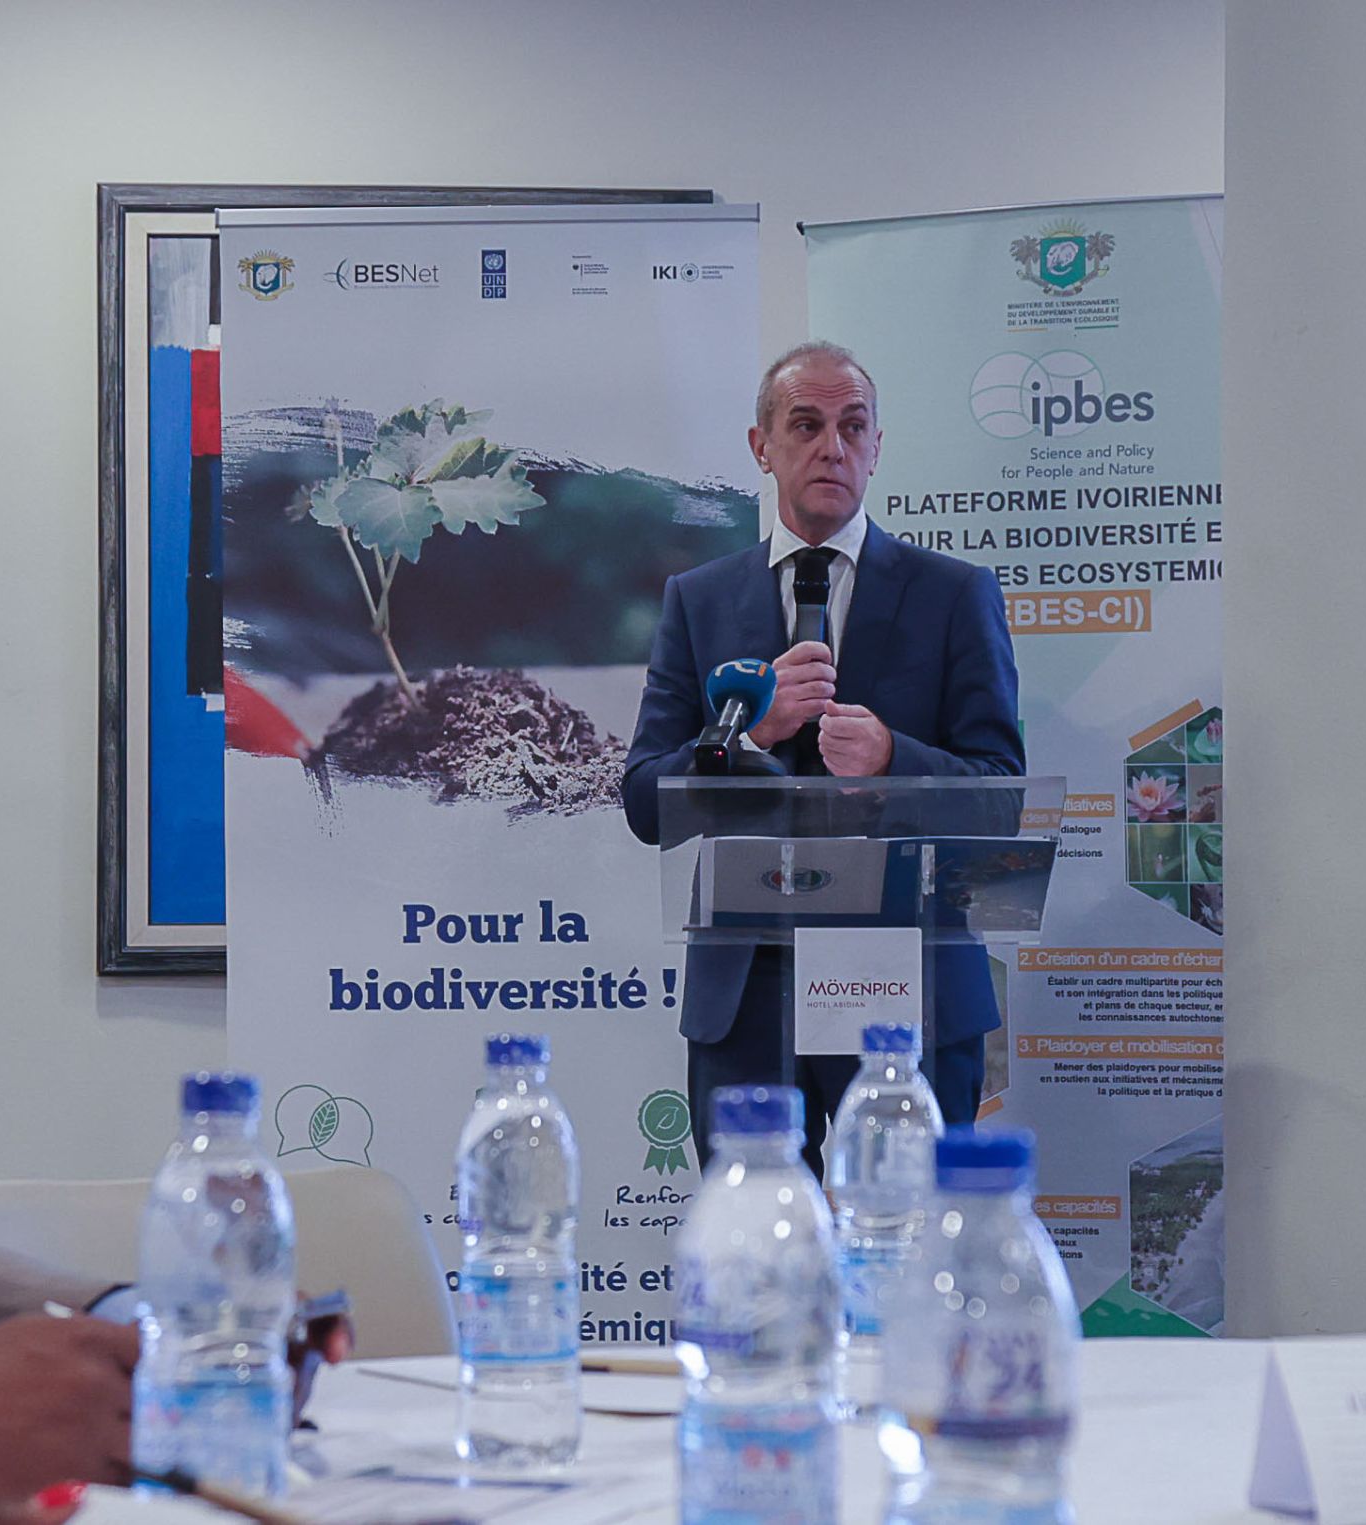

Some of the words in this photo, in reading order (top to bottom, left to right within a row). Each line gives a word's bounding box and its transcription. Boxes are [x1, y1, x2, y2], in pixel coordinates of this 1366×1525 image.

[354, 263, 439, 283] BESNet
[653, 265, 677, 280] IKI
[1030, 317, 1072, 325] TRANSITION
[1032, 380, 1155, 436] ipbes
[1030, 447, 1082, 460] Science
[1086, 445, 1112, 457] and
[1116, 444, 1155, 459] Policy
[1001, 466, 1021, 479] for
[1026, 464, 1073, 480] People
[1079, 463, 1104, 476] and
[1109, 463, 1155, 475] Nature
[887, 489, 1067, 516] PLATEFORME
[886, 530, 954, 550] OUR
[963, 529, 997, 549] LA
[1005, 517, 1196, 548] BIODIVERSITÉ
[1039, 559, 1222, 584] ECOSYSTEMI
[1060, 825, 1102, 836] dialogue
[1057, 848, 1103, 858] décisions
[402, 904, 524, 944] Pour
[539, 900, 589, 943] la
[1019, 952, 1032, 965] 2.
[1036, 951, 1095, 966] Création
[1099, 952, 1127, 966] d'un
[1131, 952, 1169, 966] cadre
[329, 967, 648, 1010] biodiversité
[661, 968, 677, 1009] !
[807, 979, 910, 996] MÖVENPICK
[1047, 975, 1079, 986] Établir
[1082, 978, 1094, 986] un
[1097, 977, 1123, 986] cadre
[1125, 977, 1178, 987] multipartite
[1181, 979, 1203, 988] pour
[1055, 990, 1064, 998] et
[1087, 989, 1139, 999] intégration
[1141, 990, 1164, 998] dans
[1167, 990, 1180, 998] les
[1083, 1002, 1093, 1010] et
[1095, 1001, 1121, 1012] plans
[1124, 1001, 1136, 1010] de
[1138, 1001, 1172, 1012] chaque
[1175, 1002, 1212, 1012] secteur,
[1078, 1013, 1092, 1021] les
[1095, 1013, 1166, 1022] connaissances
[1019, 1038, 1032, 1052] 3.
[1037, 1038, 1107, 1055] Plaidoyer
[1109, 1039, 1124, 1052] et
[1127, 1040, 1213, 1054] mobilisation
[1053, 1062, 1083, 1071] Mener
[1086, 1062, 1103, 1071] des
[1106, 1062, 1155, 1073] plaidoyers
[1158, 1064, 1180, 1073] pour
[1054, 1075, 1090, 1083] soutien
[1112, 1075, 1158, 1083] initiatives
[1161, 1076, 1170, 1084] et
[1097, 1087, 1106, 1095] la
[1109, 1087, 1150, 1097] politique
[1153, 1088, 1162, 1096] et
[1164, 1088, 1173, 1096] la
[1175, 1088, 1214, 1098] pratique
[1053, 1199, 1116, 1216] capacités
[604, 1208, 629, 1227] les
[1054, 1226, 1100, 1236] capacités
[639, 1268, 674, 1292] et
